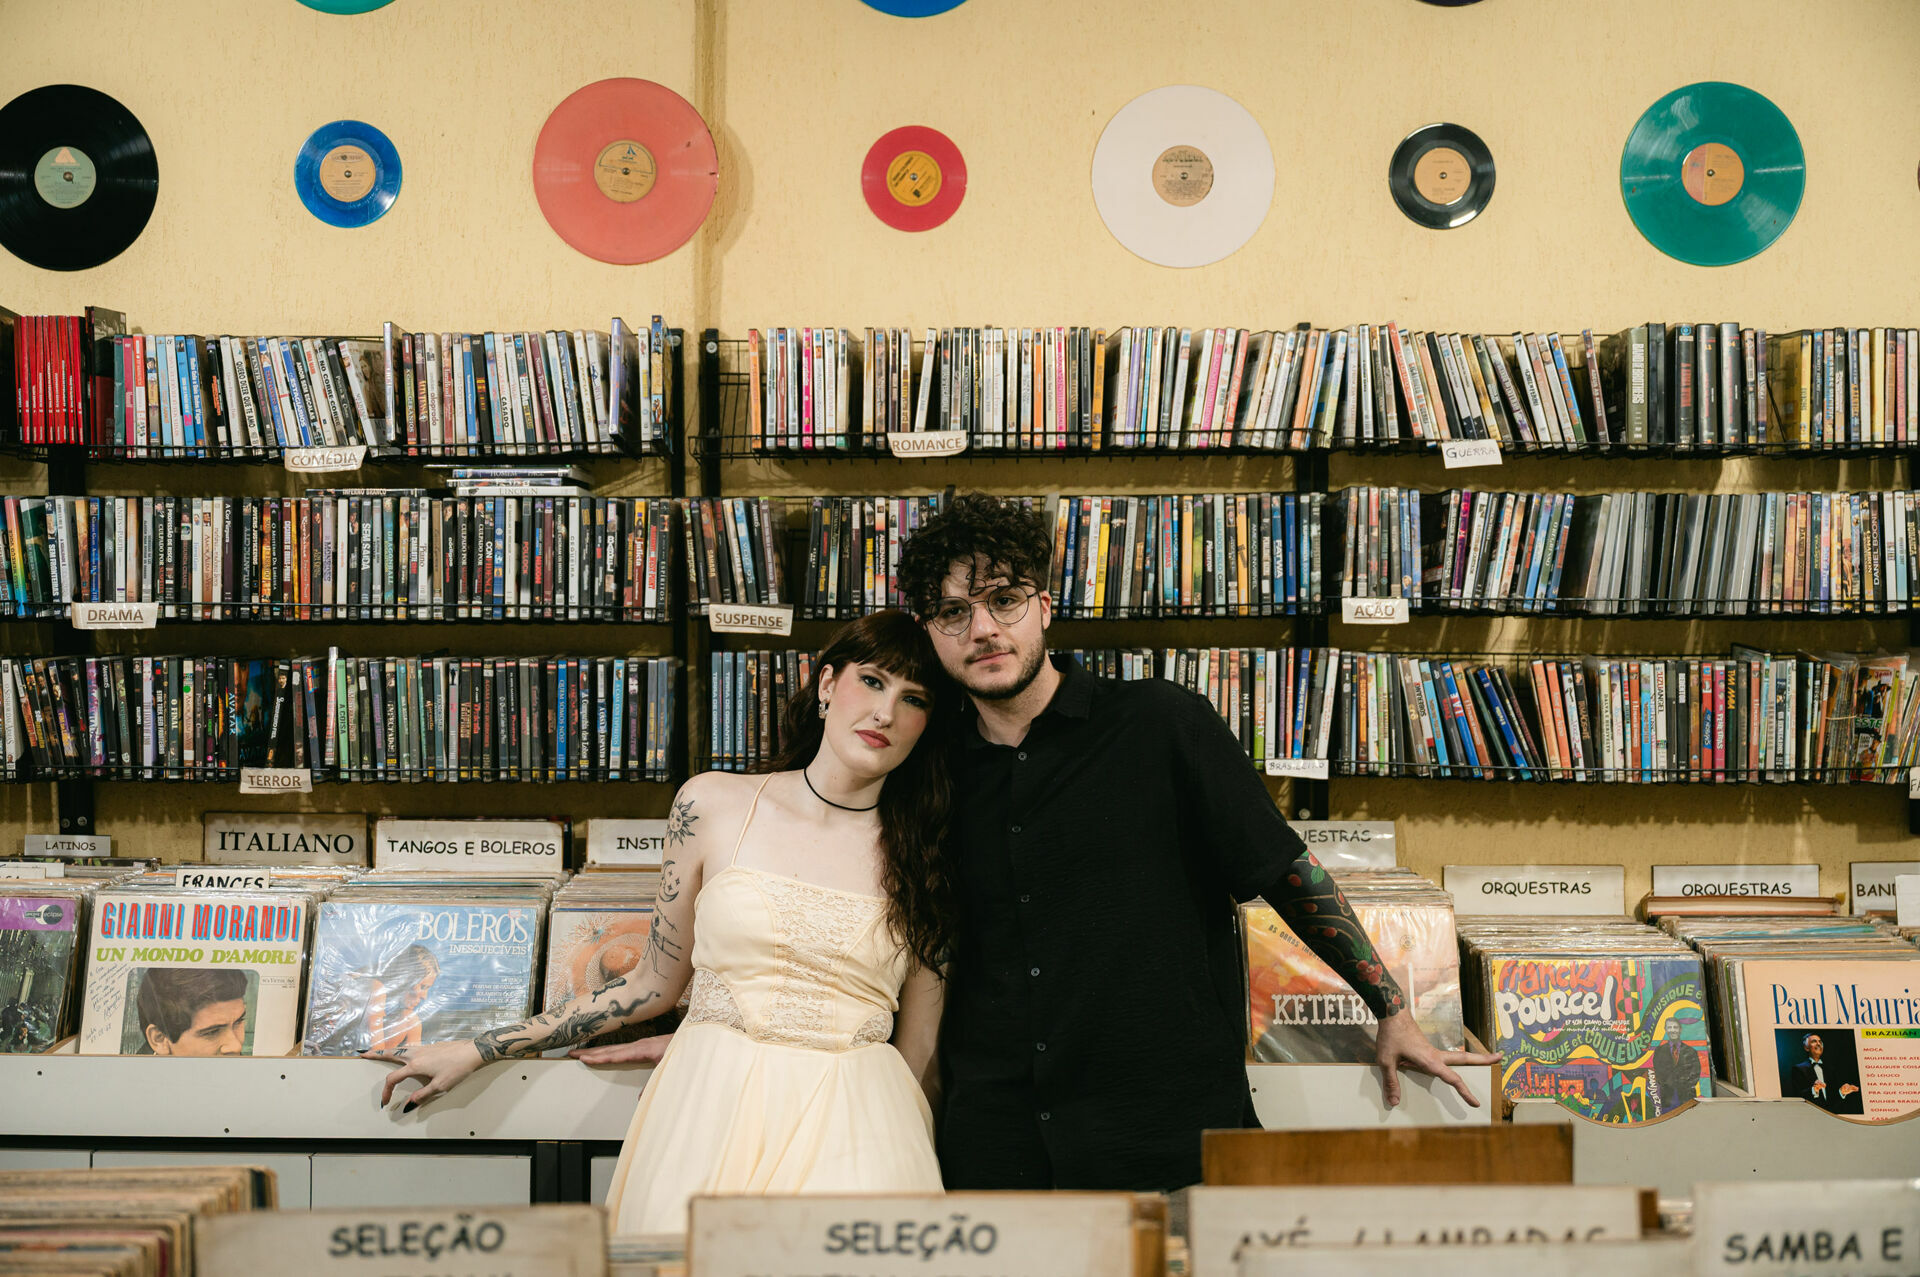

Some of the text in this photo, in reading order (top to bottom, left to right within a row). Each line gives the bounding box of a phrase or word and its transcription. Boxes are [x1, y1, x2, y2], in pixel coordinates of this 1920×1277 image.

[236, 361, 246, 379] QUERO
[239, 380, 249, 395] DIZER
[296, 362, 316, 419] AMOR SEM ESCALAS
[1632, 369, 1644, 403] BROTHERS
[242, 396, 251, 407] QUE
[501, 396, 510, 428] CASADO
[246, 415, 255, 427] AMO
[892, 437, 962, 451] ROMANCE
[291, 451, 358, 466] COMÉDIA
[1445, 447, 1497, 459] GUERRA
[499, 488, 538, 496] LINCOLN
[635, 541, 643, 566] julieta
[50, 559, 59, 596] FRONTEIRAS
[88, 608, 144, 621] DRAMA
[1354, 601, 1395, 618] AÇÃO
[715, 612, 783, 627] SUSPENSE
[712, 699, 718, 709] DE
[725, 699, 730, 709] DE
[738, 699, 743, 709] DE
[247, 774, 302, 787] TERROR
[45, 841, 96, 851] LATINOS
[218, 831, 355, 854] ITALIANO
[387, 838, 556, 856] TANGOS E BOLEROS
[1481, 880, 1592, 896] ORQUESTRAS
[1680, 882, 1792, 896] ORQUESTRAS
[43, 910, 63, 918] eclipse
[100, 902, 302, 943] GIANNI MORANDI
[417, 911, 529, 944] BOLEROS
[95, 947, 298, 965] UN MONDO D'AMORE
[1769, 983, 1832, 1026] Paul
[328, 1211, 507, 1262] SELEÇÃO
[823, 1213, 999, 1262] SELEÇÃO
[1722, 1226, 1904, 1264] SAMBA E
